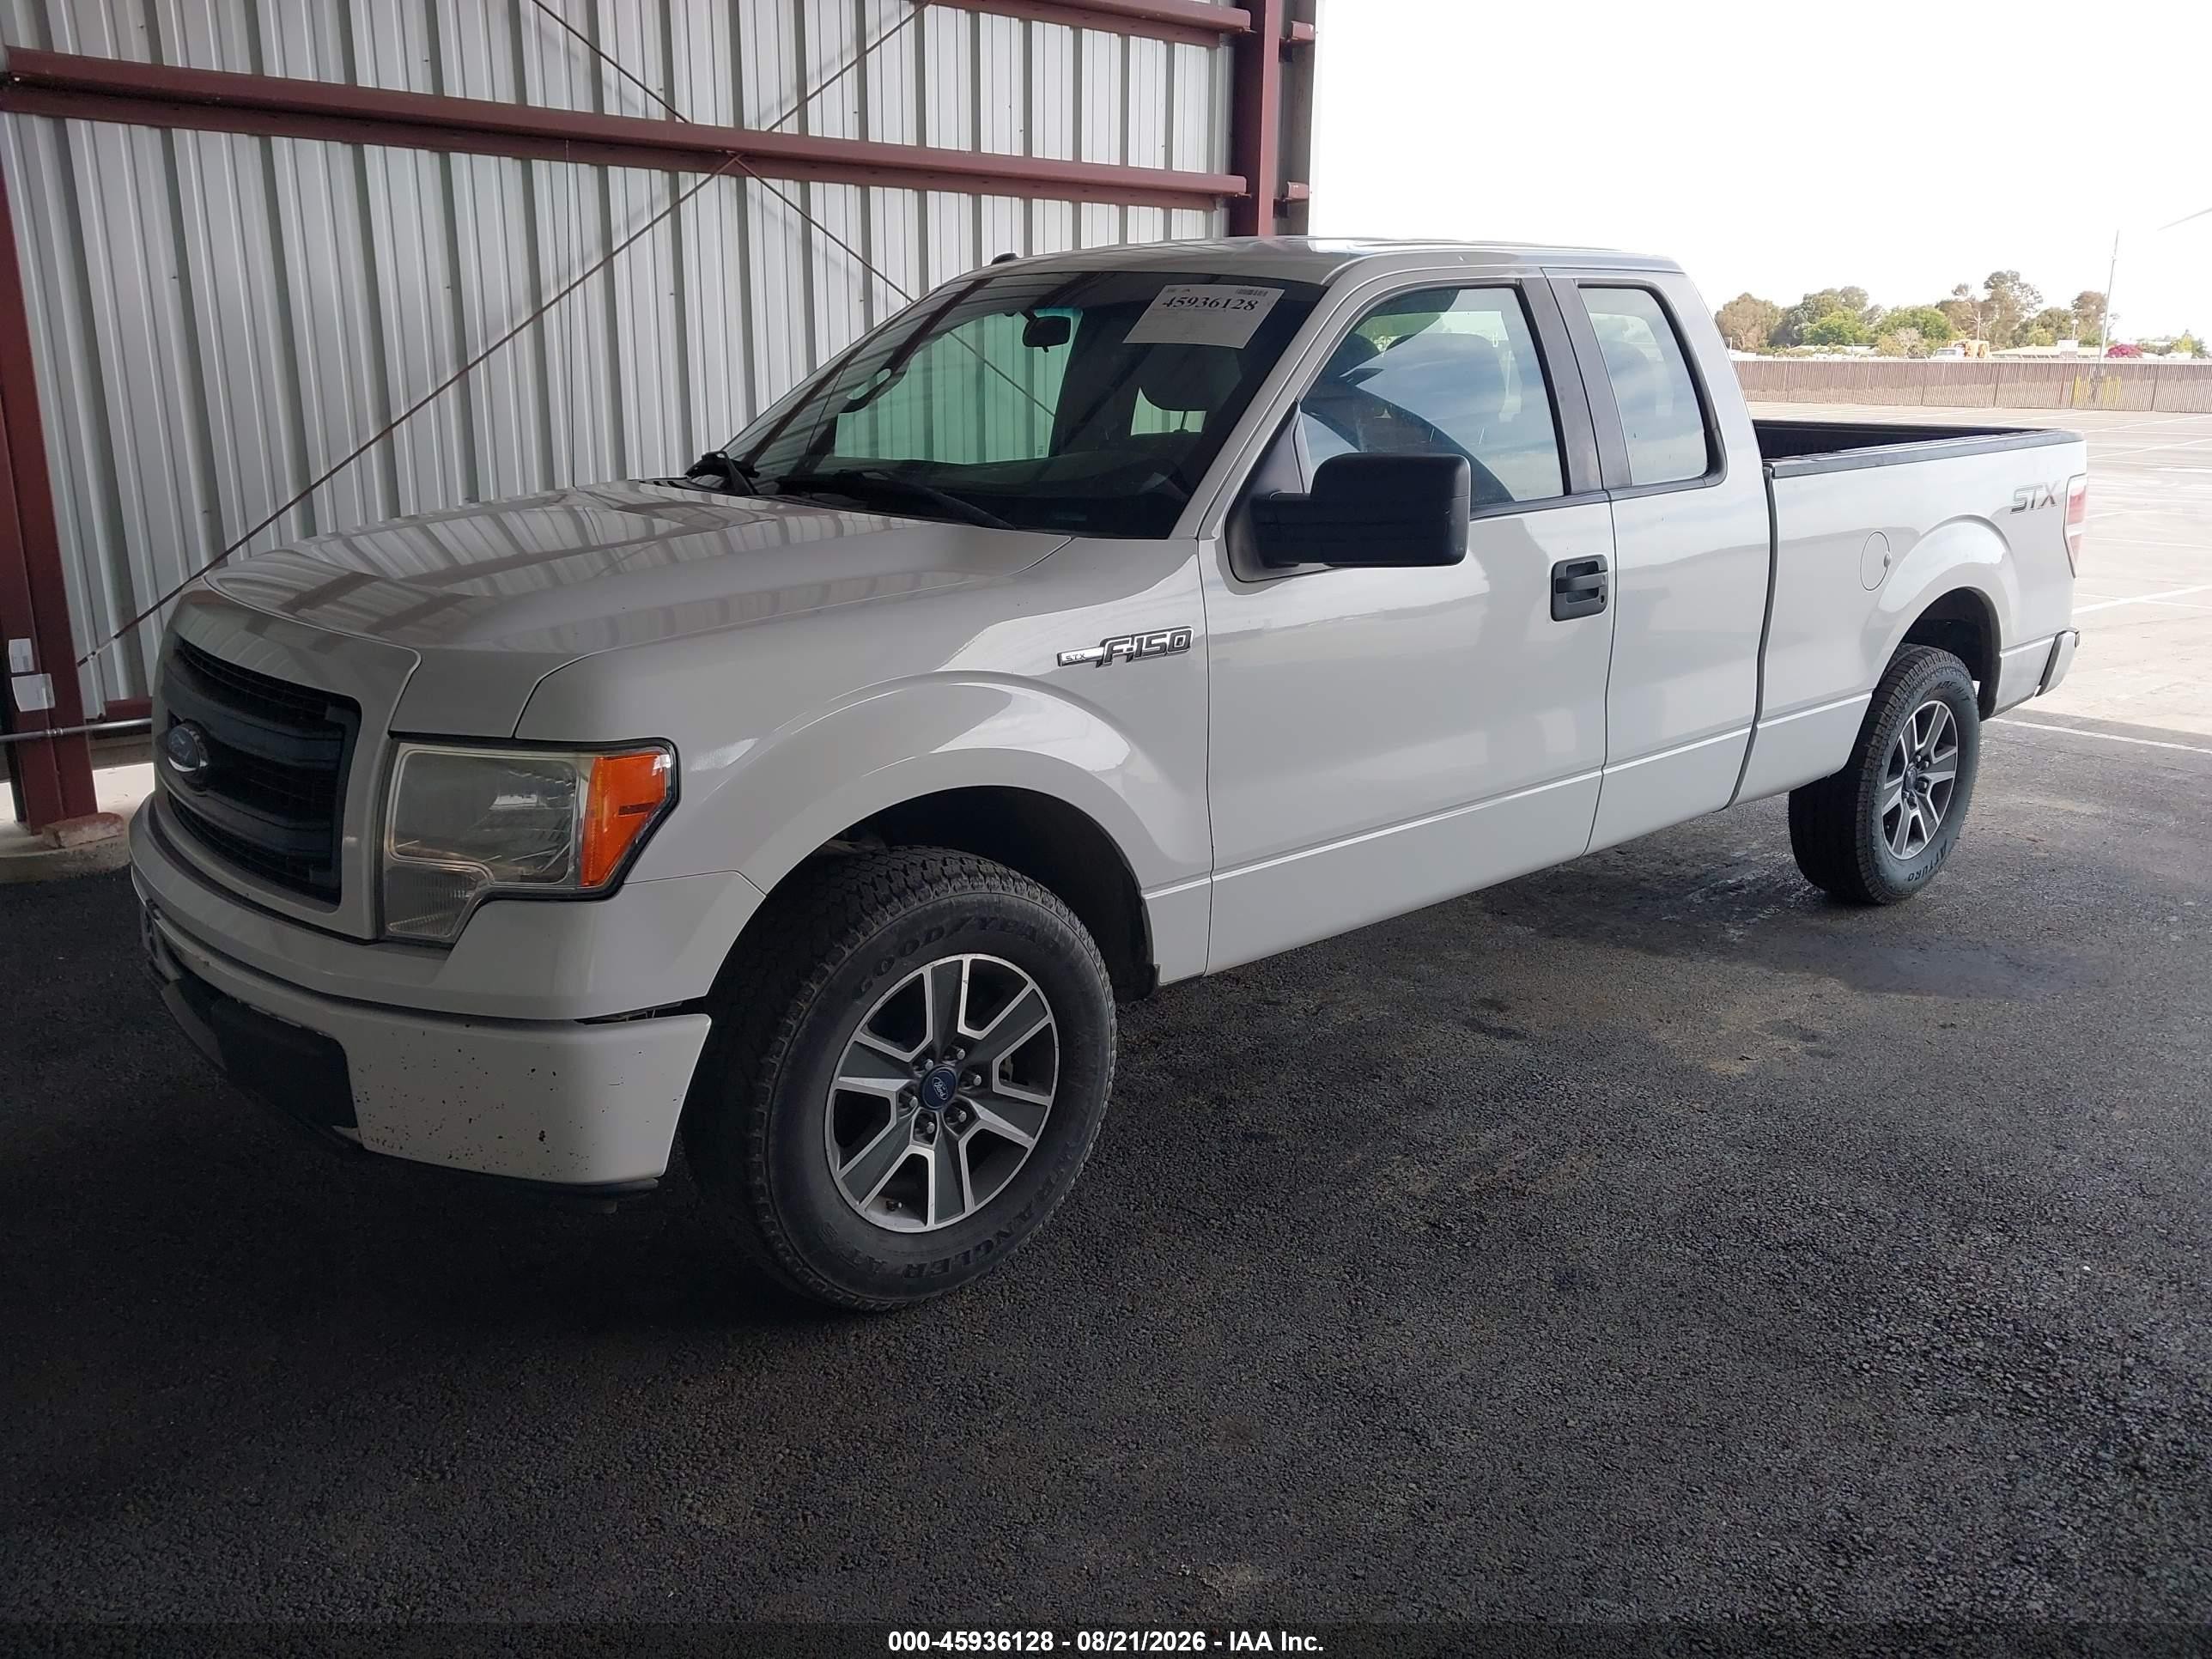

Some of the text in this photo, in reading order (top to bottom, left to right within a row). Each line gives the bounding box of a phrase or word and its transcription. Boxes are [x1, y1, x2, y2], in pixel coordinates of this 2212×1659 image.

[1161, 295, 1259, 312] 45936128
[2010, 481, 2061, 514] STX
[1065, 627, 1194, 665] STX F-150
[933, 1078, 948, 1099] Ford
